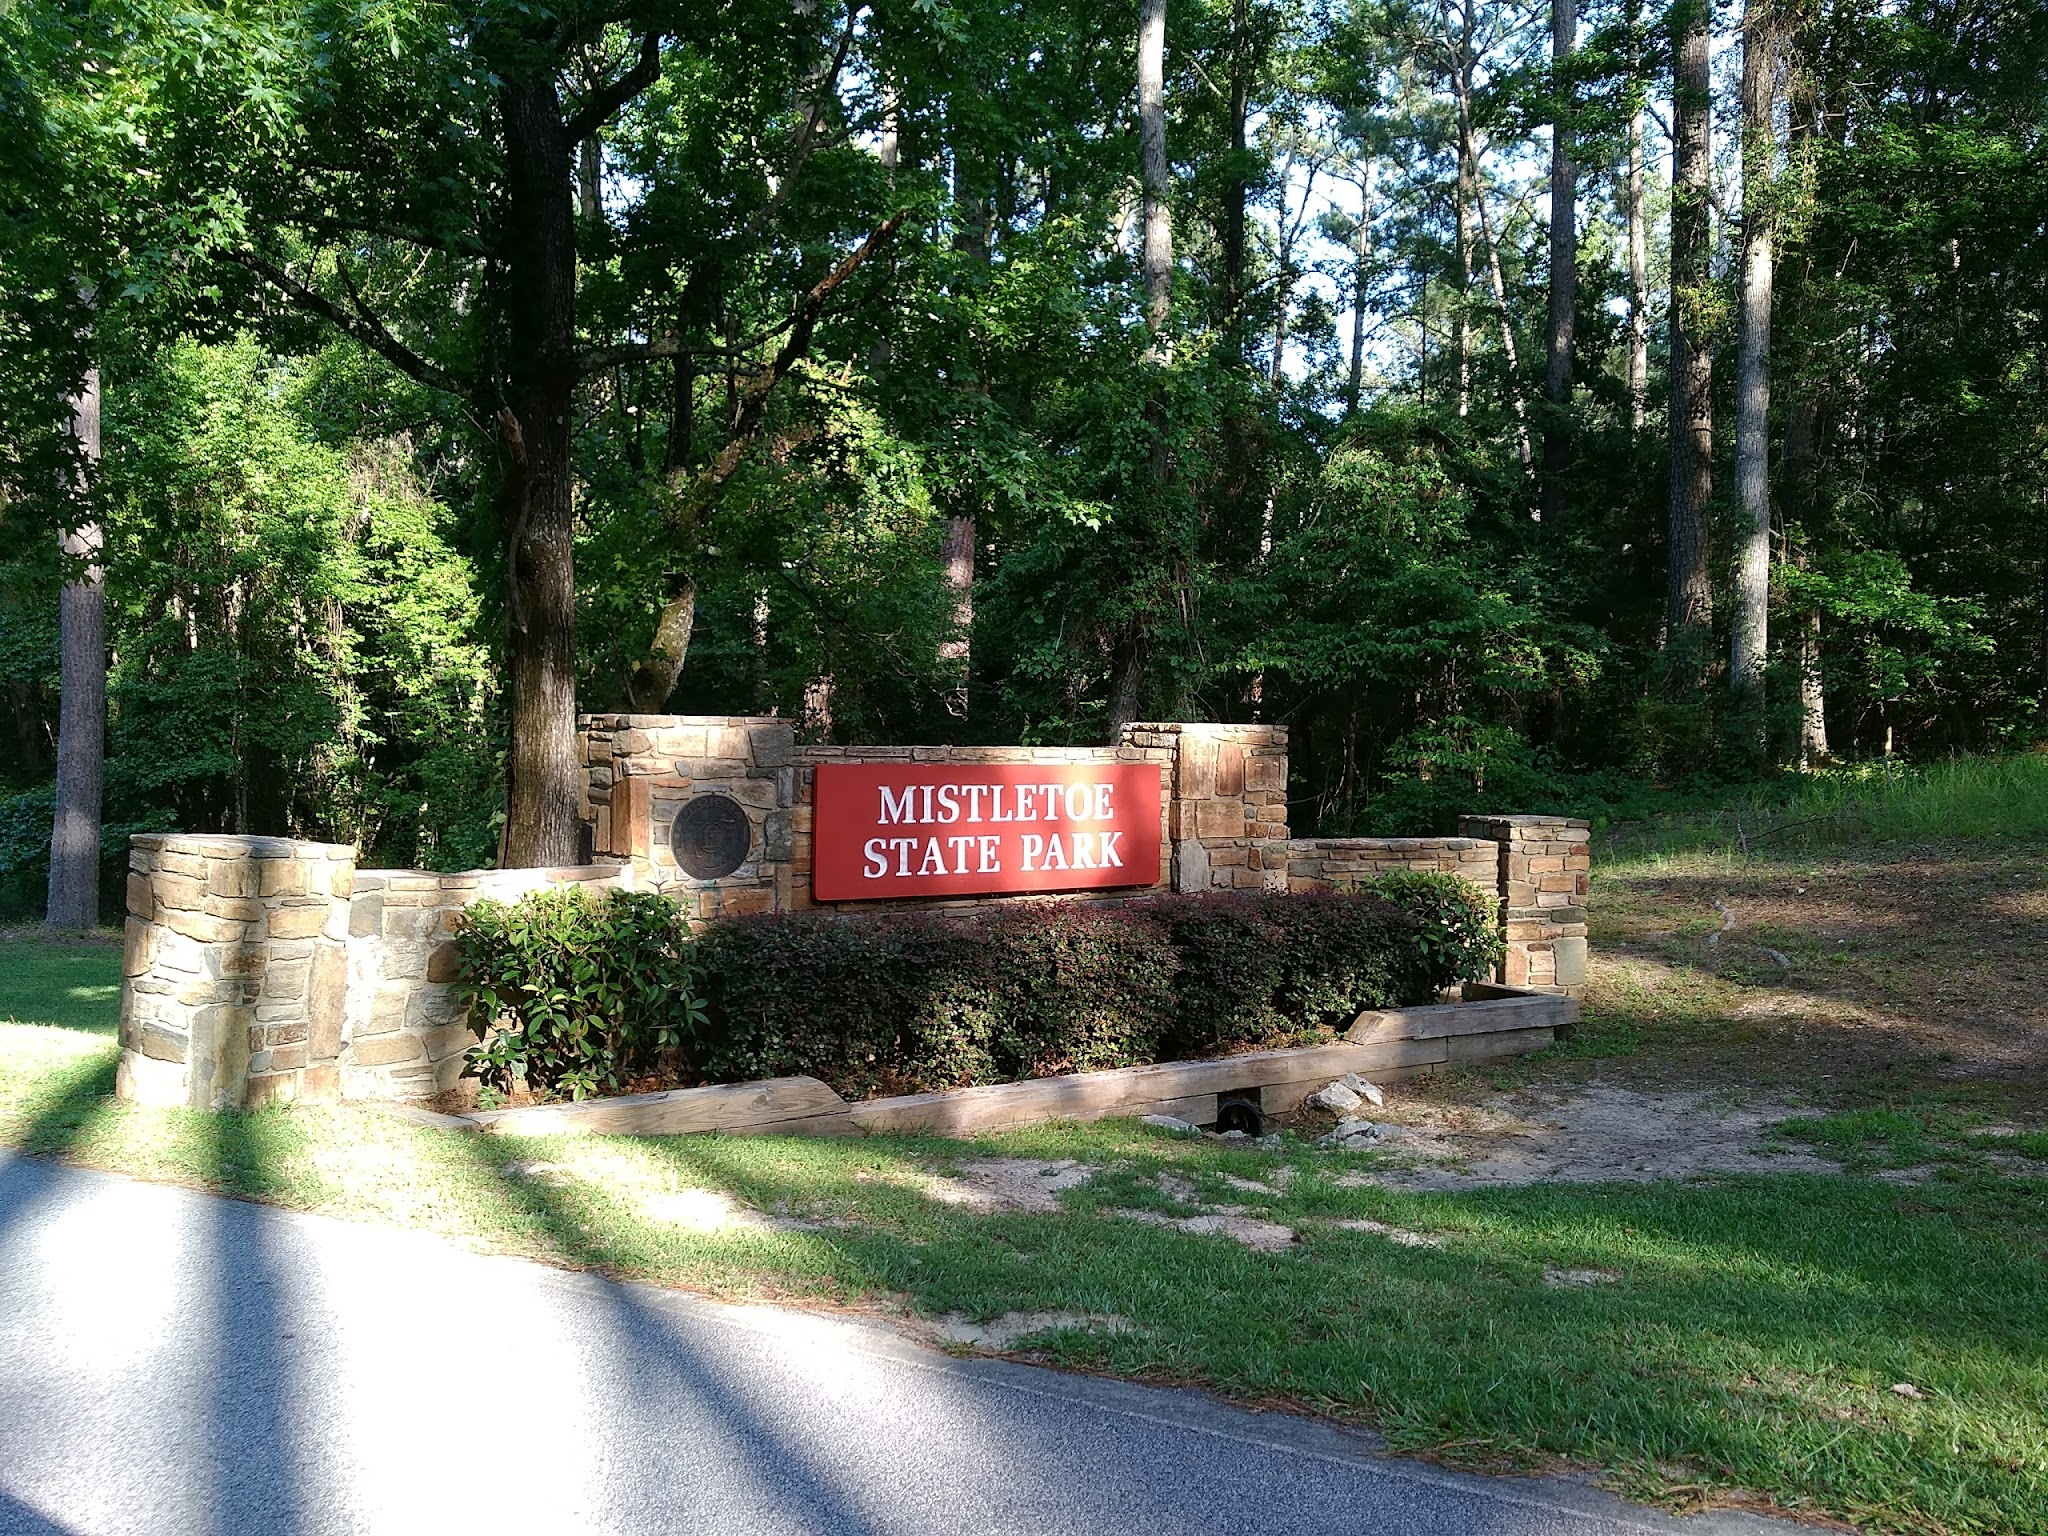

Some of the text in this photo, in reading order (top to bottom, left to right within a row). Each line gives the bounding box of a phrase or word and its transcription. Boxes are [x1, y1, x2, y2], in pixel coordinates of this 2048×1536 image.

[877, 782, 1114, 825] MISTLETOE
[863, 831, 1124, 878] STATE PARK
